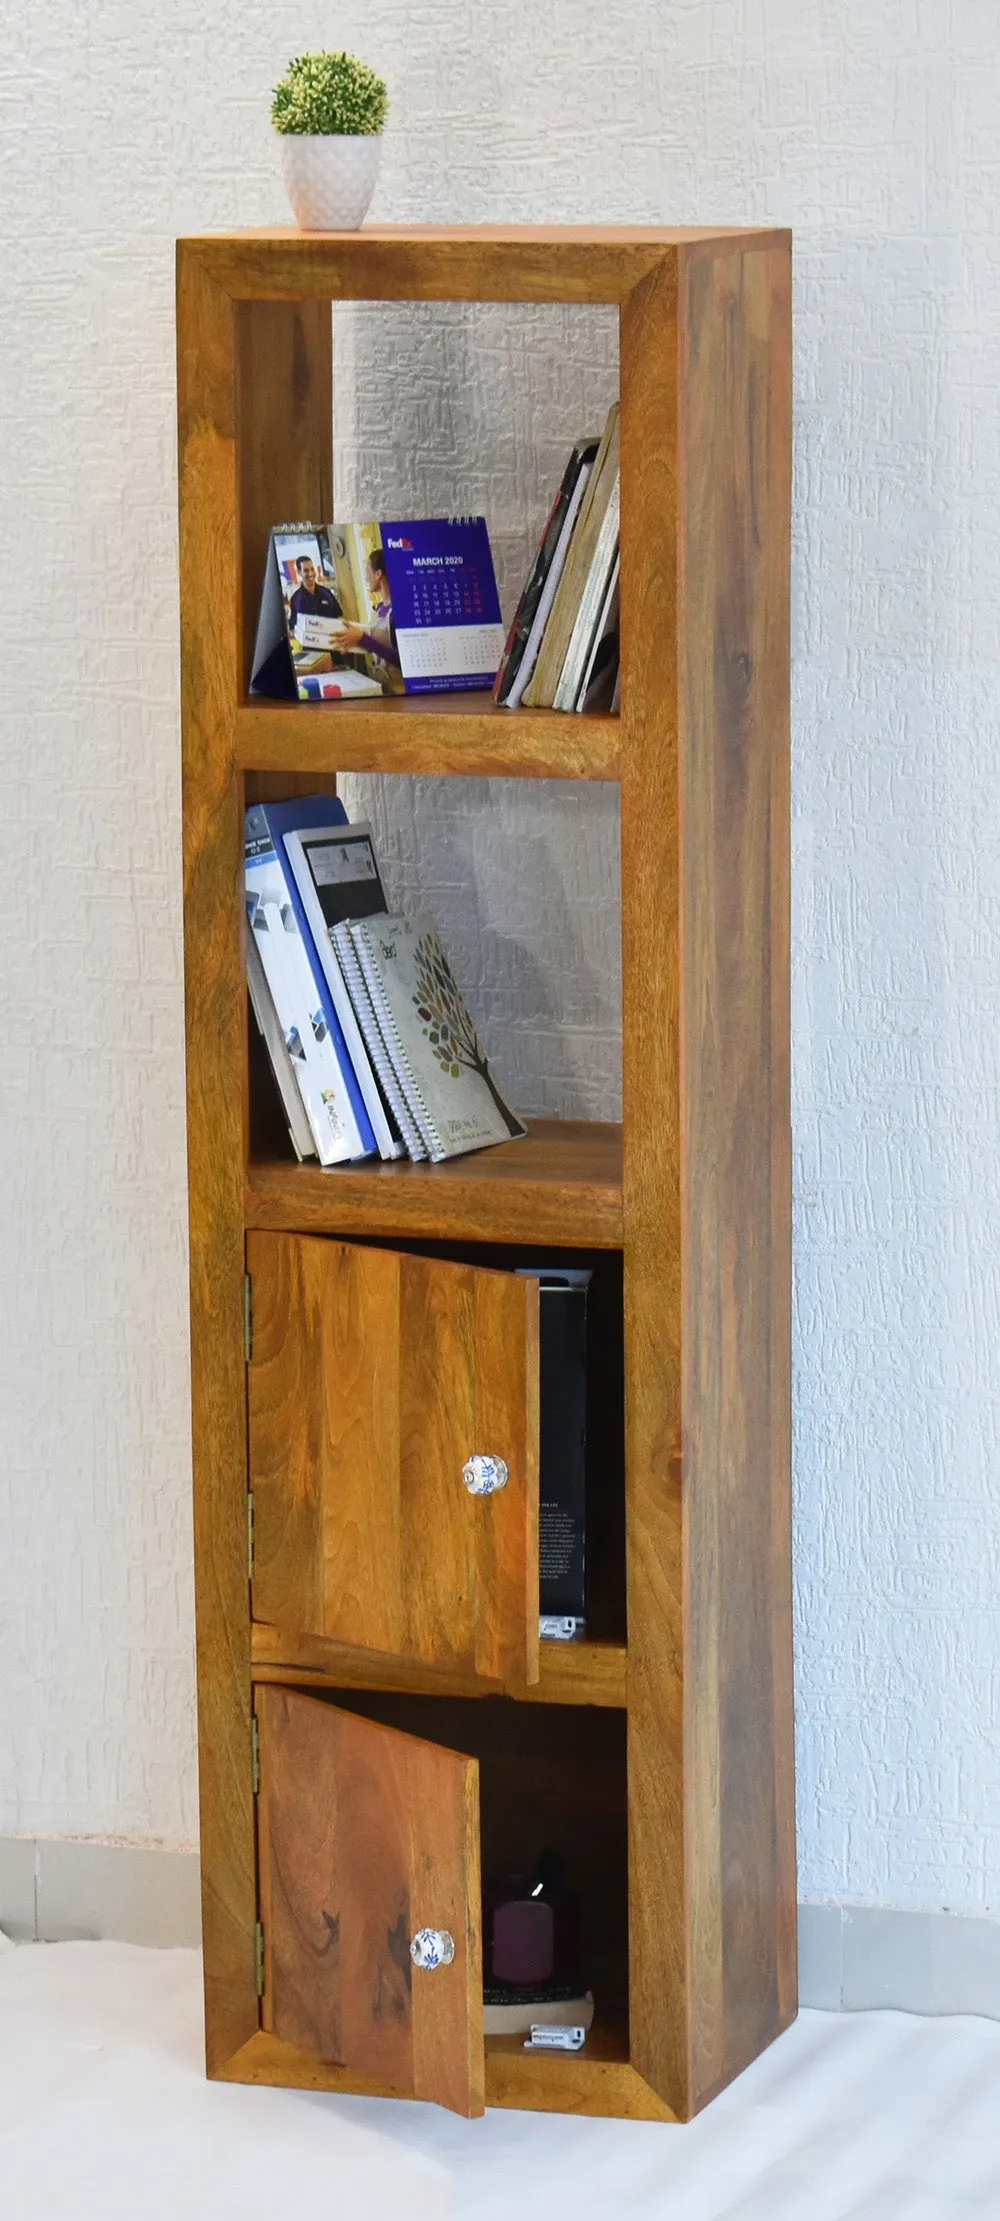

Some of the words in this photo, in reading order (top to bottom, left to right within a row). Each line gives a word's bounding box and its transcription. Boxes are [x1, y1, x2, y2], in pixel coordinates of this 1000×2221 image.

[387, 538, 413, 548] FedEx
[413, 557, 443, 567] MARCH
[445, 556, 463, 565] 2020
